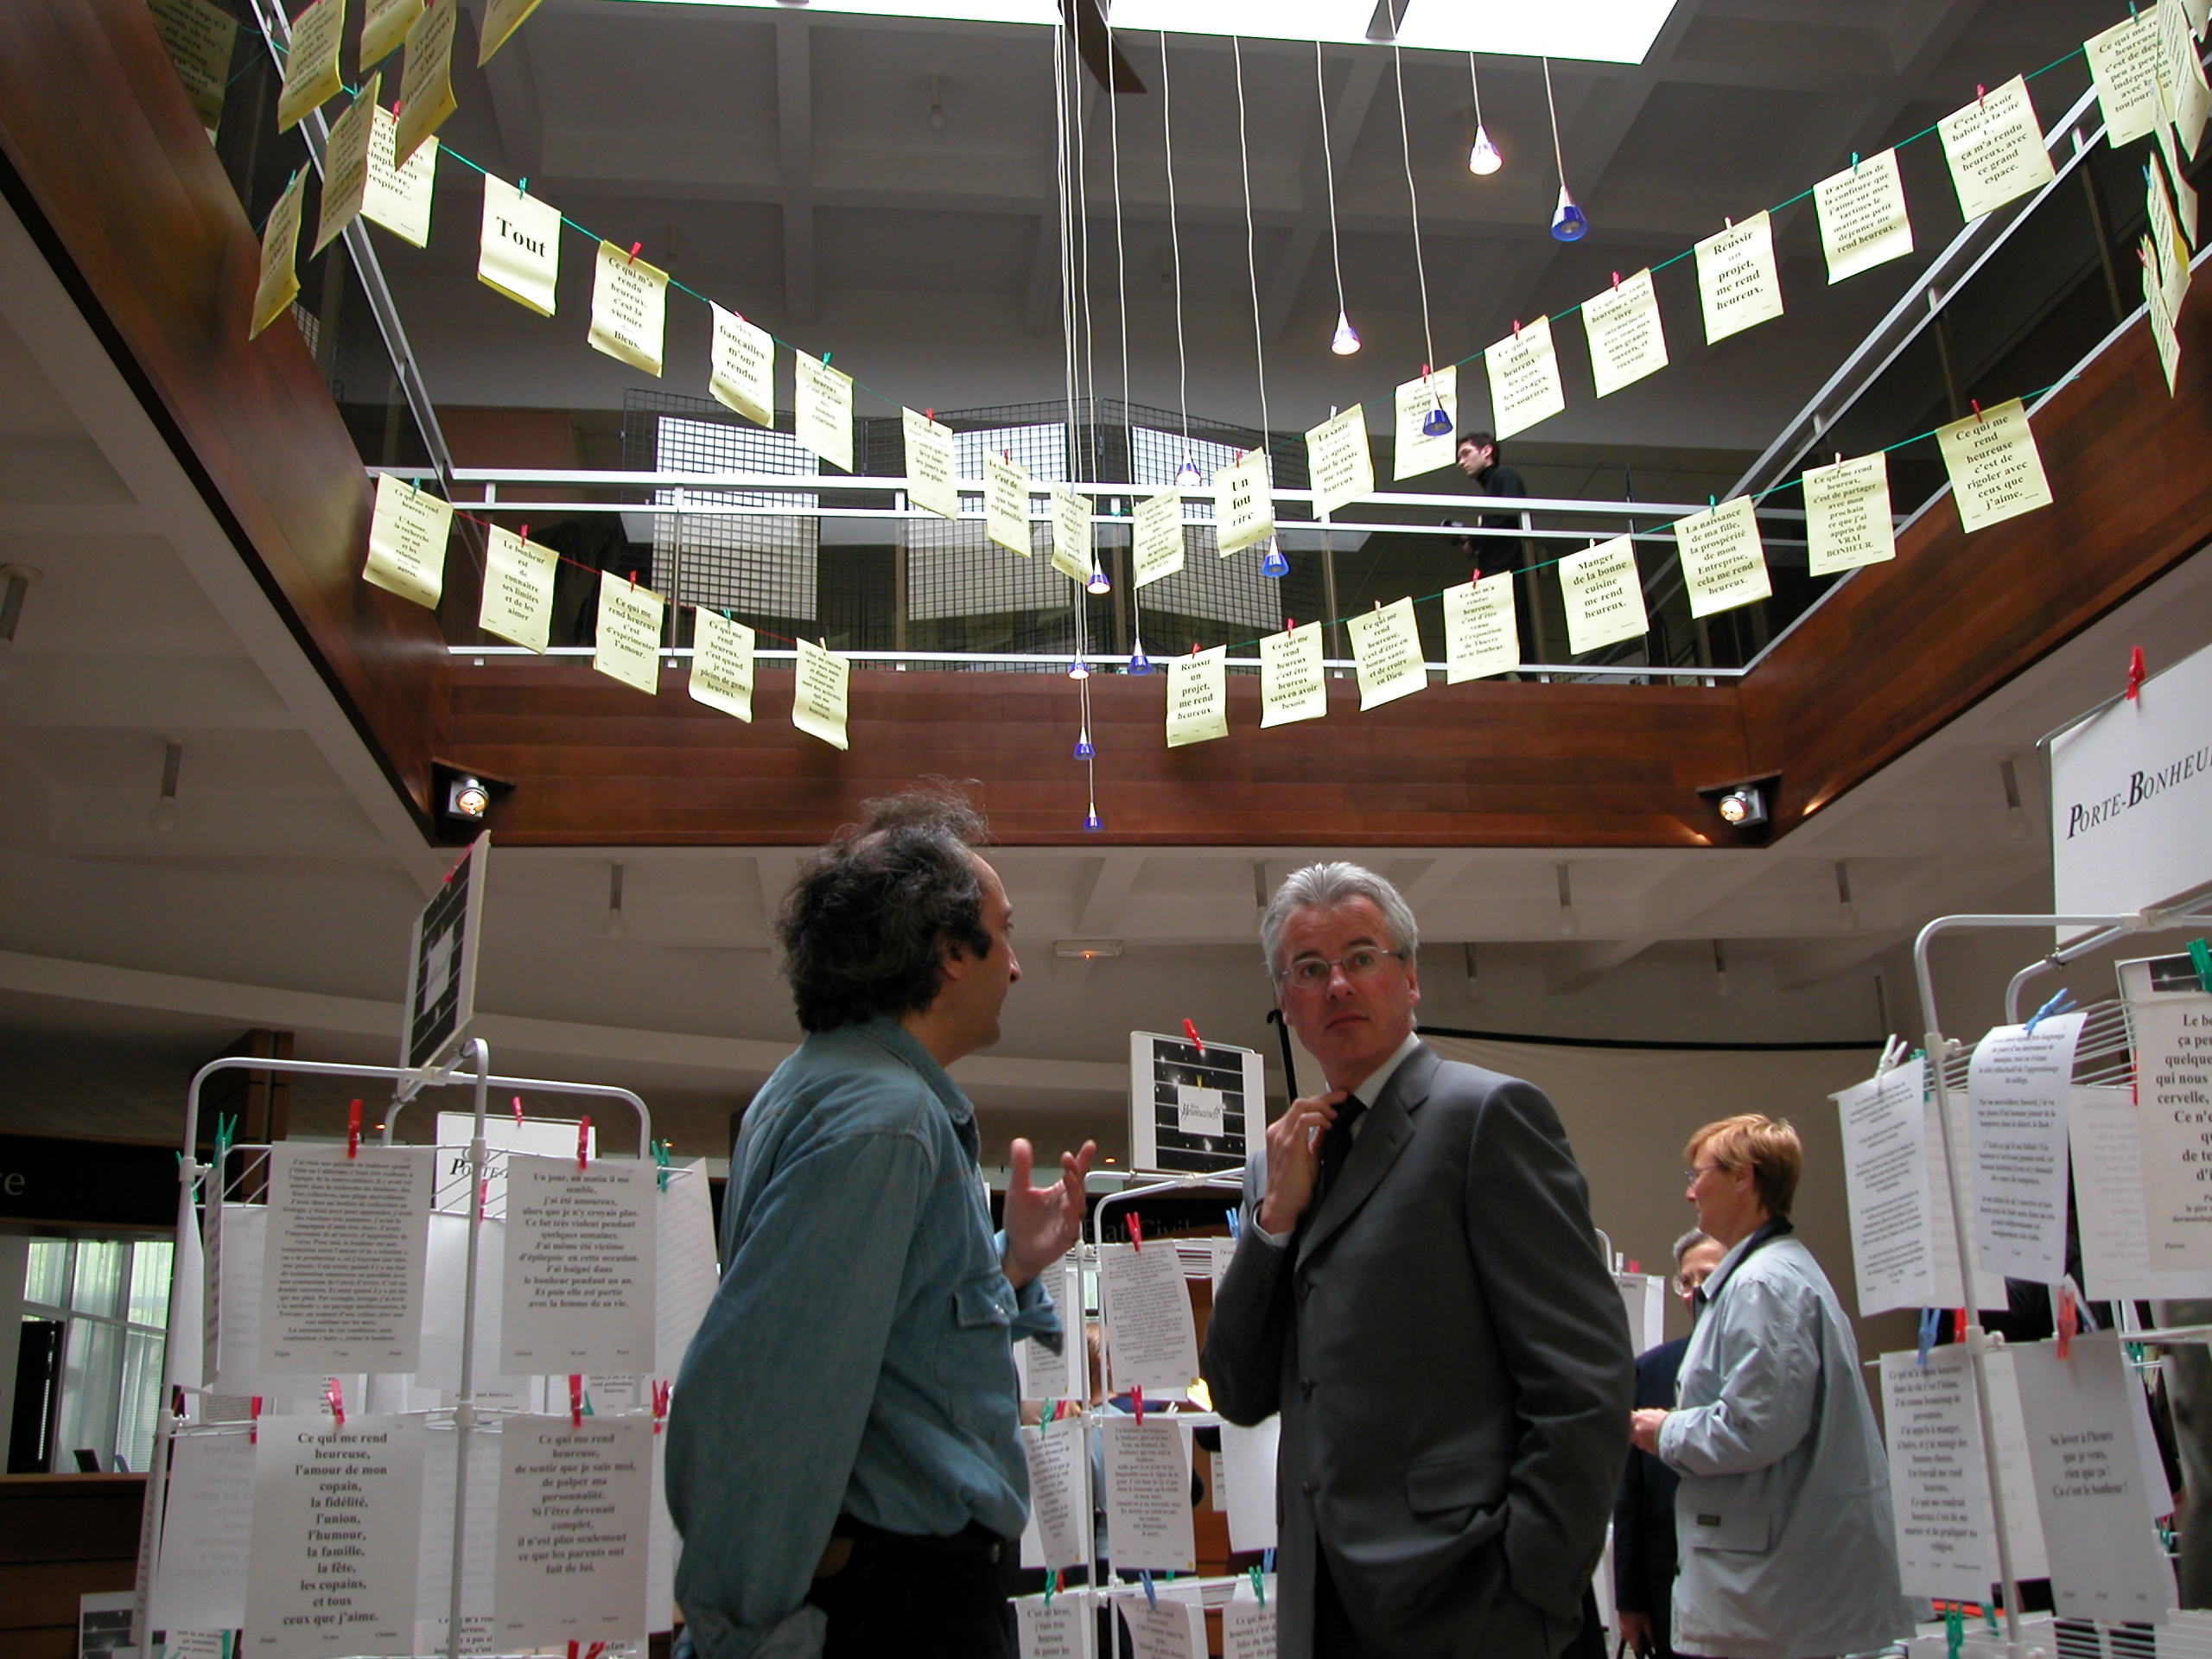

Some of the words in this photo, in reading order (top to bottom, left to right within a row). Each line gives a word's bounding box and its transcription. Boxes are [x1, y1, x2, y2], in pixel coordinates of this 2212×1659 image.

[1953, 112, 1978, 130] C'est
[1980, 93, 2012, 117] d'avoir
[1961, 150, 1973, 162] ça
[1974, 140, 1993, 154] m'a
[1993, 124, 2023, 143] rendu
[2005, 132, 2027, 149] avec
[1977, 166, 1988, 176] ce
[1989, 148, 2019, 172] grand
[496, 215, 546, 258] Tout
[1713, 232, 1752, 256] Réussir
[607, 257, 621, 270] Ce
[621, 266, 637, 279] qui
[638, 274, 654, 289] m'a
[617, 276, 642, 294] rendu
[1716, 284, 1732, 296] me
[1735, 269, 1760, 288] rend
[613, 298, 632, 312] c'est
[611, 308, 643, 328] victoire
[720, 325, 765, 360] fiançailles
[728, 346, 755, 368] m'ont
[727, 360, 757, 383] rendue
[1955, 430, 1971, 441] Ce
[1973, 421, 1991, 436] qui
[1992, 416, 2008, 428] me
[1974, 431, 1999, 448] rend
[1966, 441, 2012, 464] heureuse
[1974, 459, 1999, 474] c'est
[2000, 454, 2012, 464] de
[1967, 471, 2002, 490] rigoler
[2004, 461, 2027, 476] avec
[1812, 493, 1831, 505] c'est
[1831, 491, 1842, 499] de
[1842, 483, 1877, 499] partager
[1978, 484, 2002, 499] ceux
[2004, 476, 2024, 491] que
[1232, 495, 1251, 510] fou
[1232, 512, 1254, 527] rire
[1685, 525, 1699, 535] La
[1700, 509, 1741, 530] naissance
[1689, 547, 1699, 556] la
[1700, 529, 1746, 554] prospérité
[1691, 534, 1702, 543] de
[1704, 529, 1719, 539] ma
[1837, 533, 1861, 545] VRAI
[503, 539, 513, 550] Le
[514, 545, 545, 565] bonheur
[1703, 552, 1714, 562] de
[1716, 545, 1737, 557] mon
[518, 559, 529, 569] est
[1578, 553, 1614, 570] Manger
[1573, 575, 1585, 586] de
[1586, 572, 1596, 582] la
[1597, 562, 1627, 577] bonne
[1696, 575, 1715, 588] cela
[1716, 570, 1731, 581] me
[1732, 561, 1754, 575] rend
[502, 583, 514, 593] ses
[514, 587, 539, 604] limites
[1585, 578, 1618, 594] cuisine
[505, 595, 512, 604] et
[513, 598, 524, 608] de
[524, 602, 535, 613] les
[1584, 597, 1598, 607] me
[1600, 587, 1623, 601] rend
[507, 607, 530, 621] aimer
[614, 596, 627, 611] Ce
[626, 603, 639, 614] qui
[640, 609, 652, 619] me
[608, 607, 626, 619] rend
[626, 613, 656, 632] heureux
[606, 626, 656, 652] d'expérimenter
[623, 624, 640, 636] c'est
[705, 650, 721, 661] c'est
[721, 657, 744, 671] quand
[699, 668, 721, 682] pleins
[730, 681, 746, 692] gens
[1190, 673, 1201, 682] un
[1179, 700, 1192, 709] me
[1193, 692, 1213, 705] rend
[1269, 693, 1287, 702] sans
[1298, 683, 1318, 696] avoir
[2183, 1014, 2198, 1027] Le
[2177, 1036, 2191, 1048] ça
[2155, 1072, 2176, 1087] qui
[2178, 1073, 2209, 1084] nous
[2157, 1090, 2209, 1105] cervelle,
[2174, 1109, 2192, 1123] Ce
[2182, 1149, 2198, 1162] de
[297, 1433, 315, 1444] Ce
[316, 1432, 337, 1446] qui
[340, 1435, 358, 1444] me
[360, 1432, 388, 1444] rend
[538, 1433, 554, 1446] Ce
[554, 1433, 572, 1447] qui
[573, 1435, 589, 1444] me
[590, 1433, 615, 1445] rend
[295, 1464, 342, 1476] l'amour
[344, 1464, 359, 1476] de
[361, 1466, 387, 1476] mon
[310, 1497, 321, 1509] la
[307, 1546, 318, 1558] la
[316, 1562, 328, 1574] la
[300, 1580, 316, 1592] les
[312, 1596, 324, 1608] et
[327, 1597, 353, 1607] tous
[283, 1616, 310, 1626] ceux
[313, 1615, 336, 1627] que
